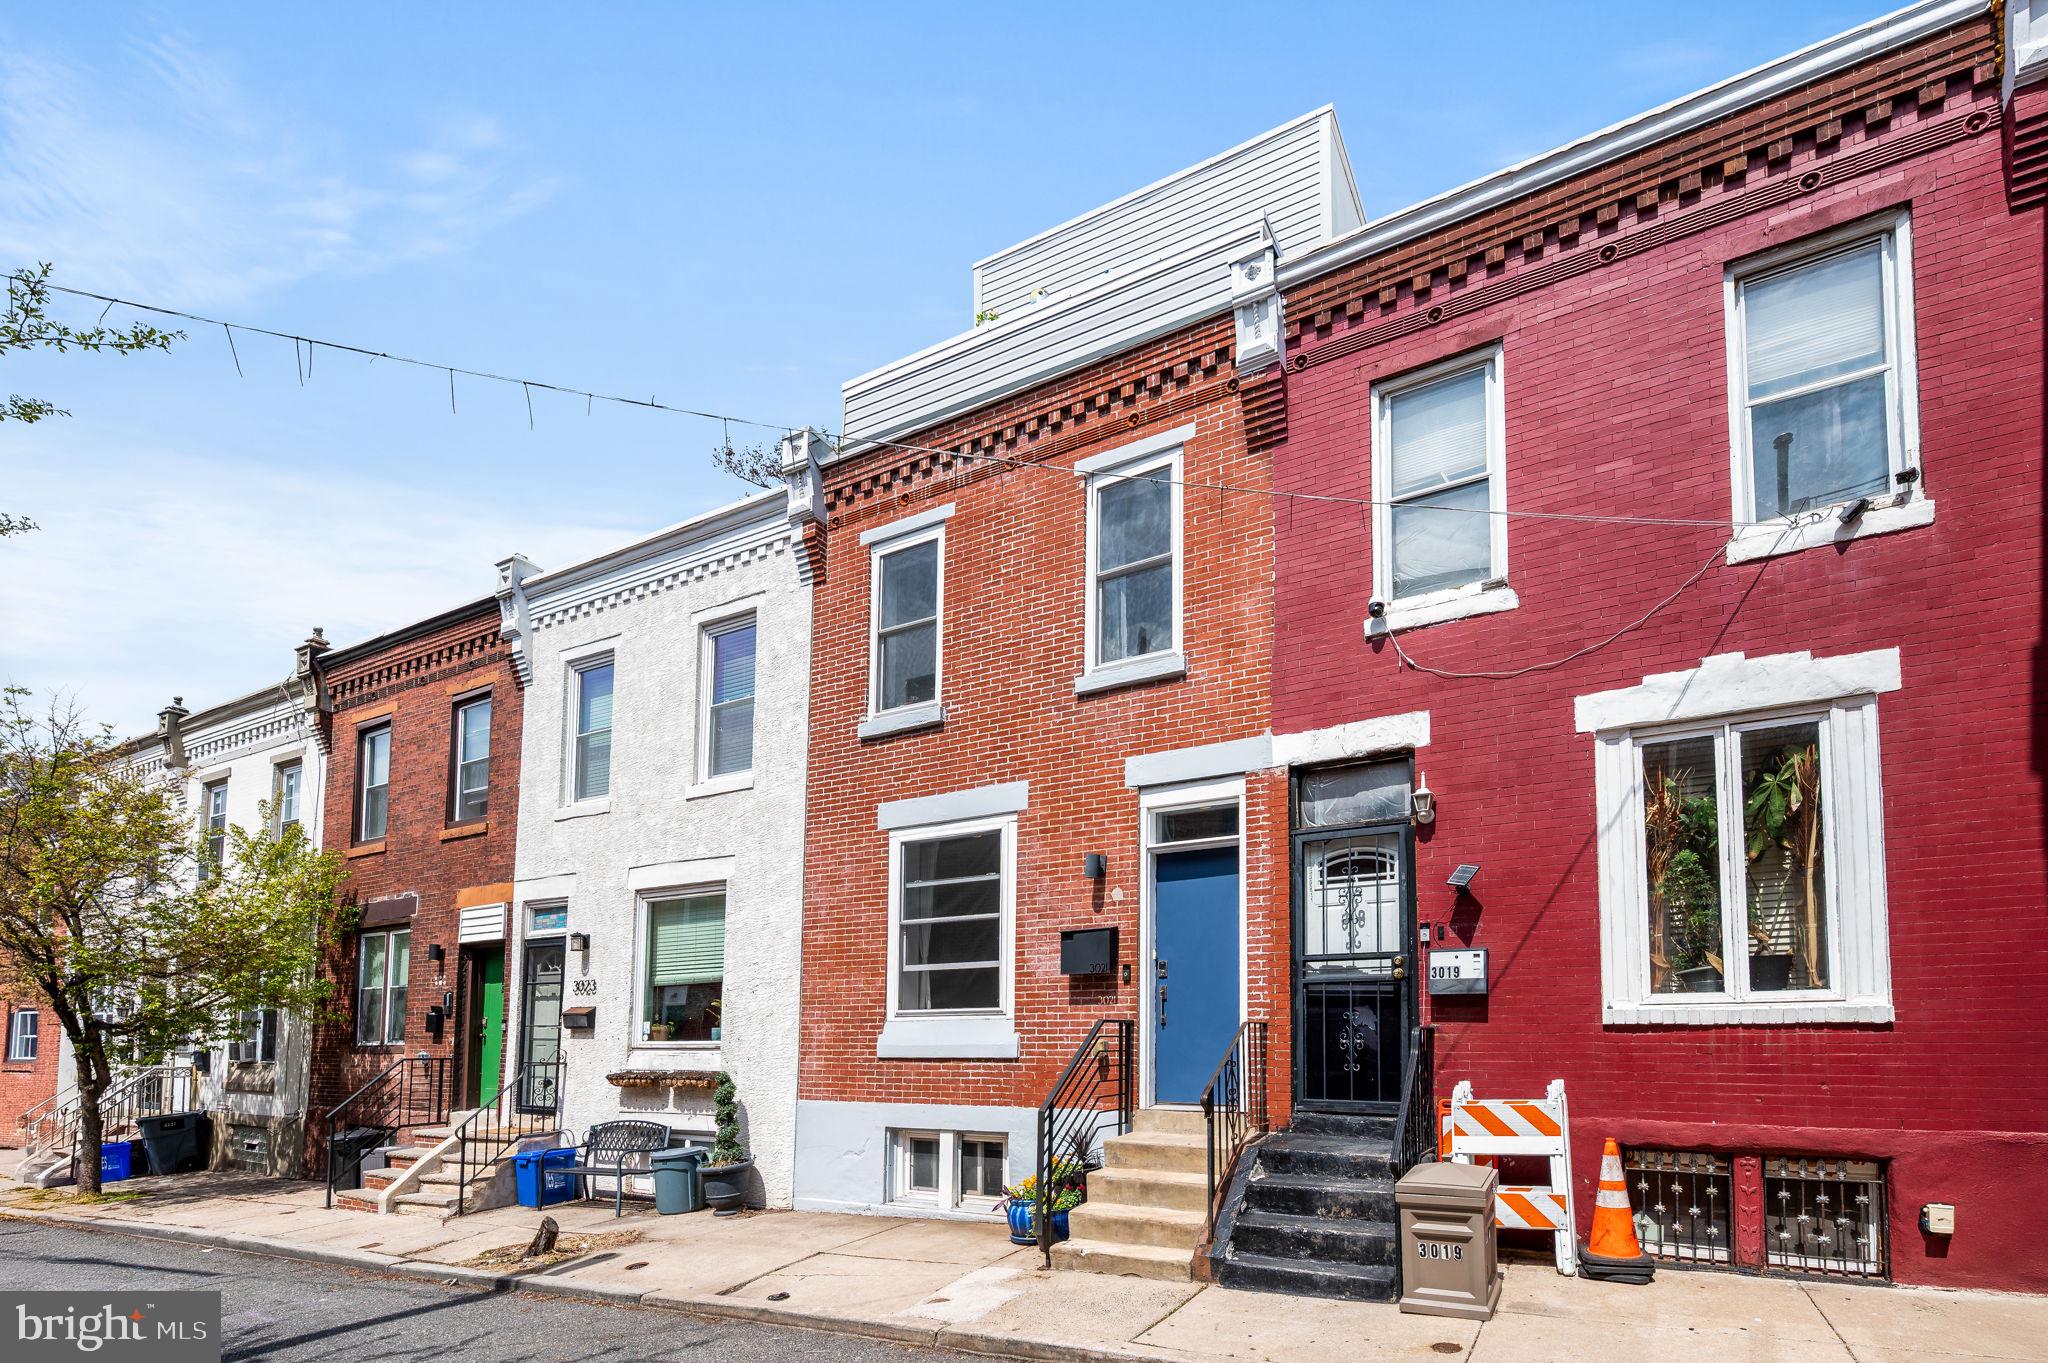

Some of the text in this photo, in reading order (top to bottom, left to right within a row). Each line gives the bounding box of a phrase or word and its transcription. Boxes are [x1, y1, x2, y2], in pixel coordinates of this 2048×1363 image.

[1431, 966, 1460, 979] 3019
[573, 979, 597, 993] 3023
[1418, 1243, 1463, 1261] 3019
